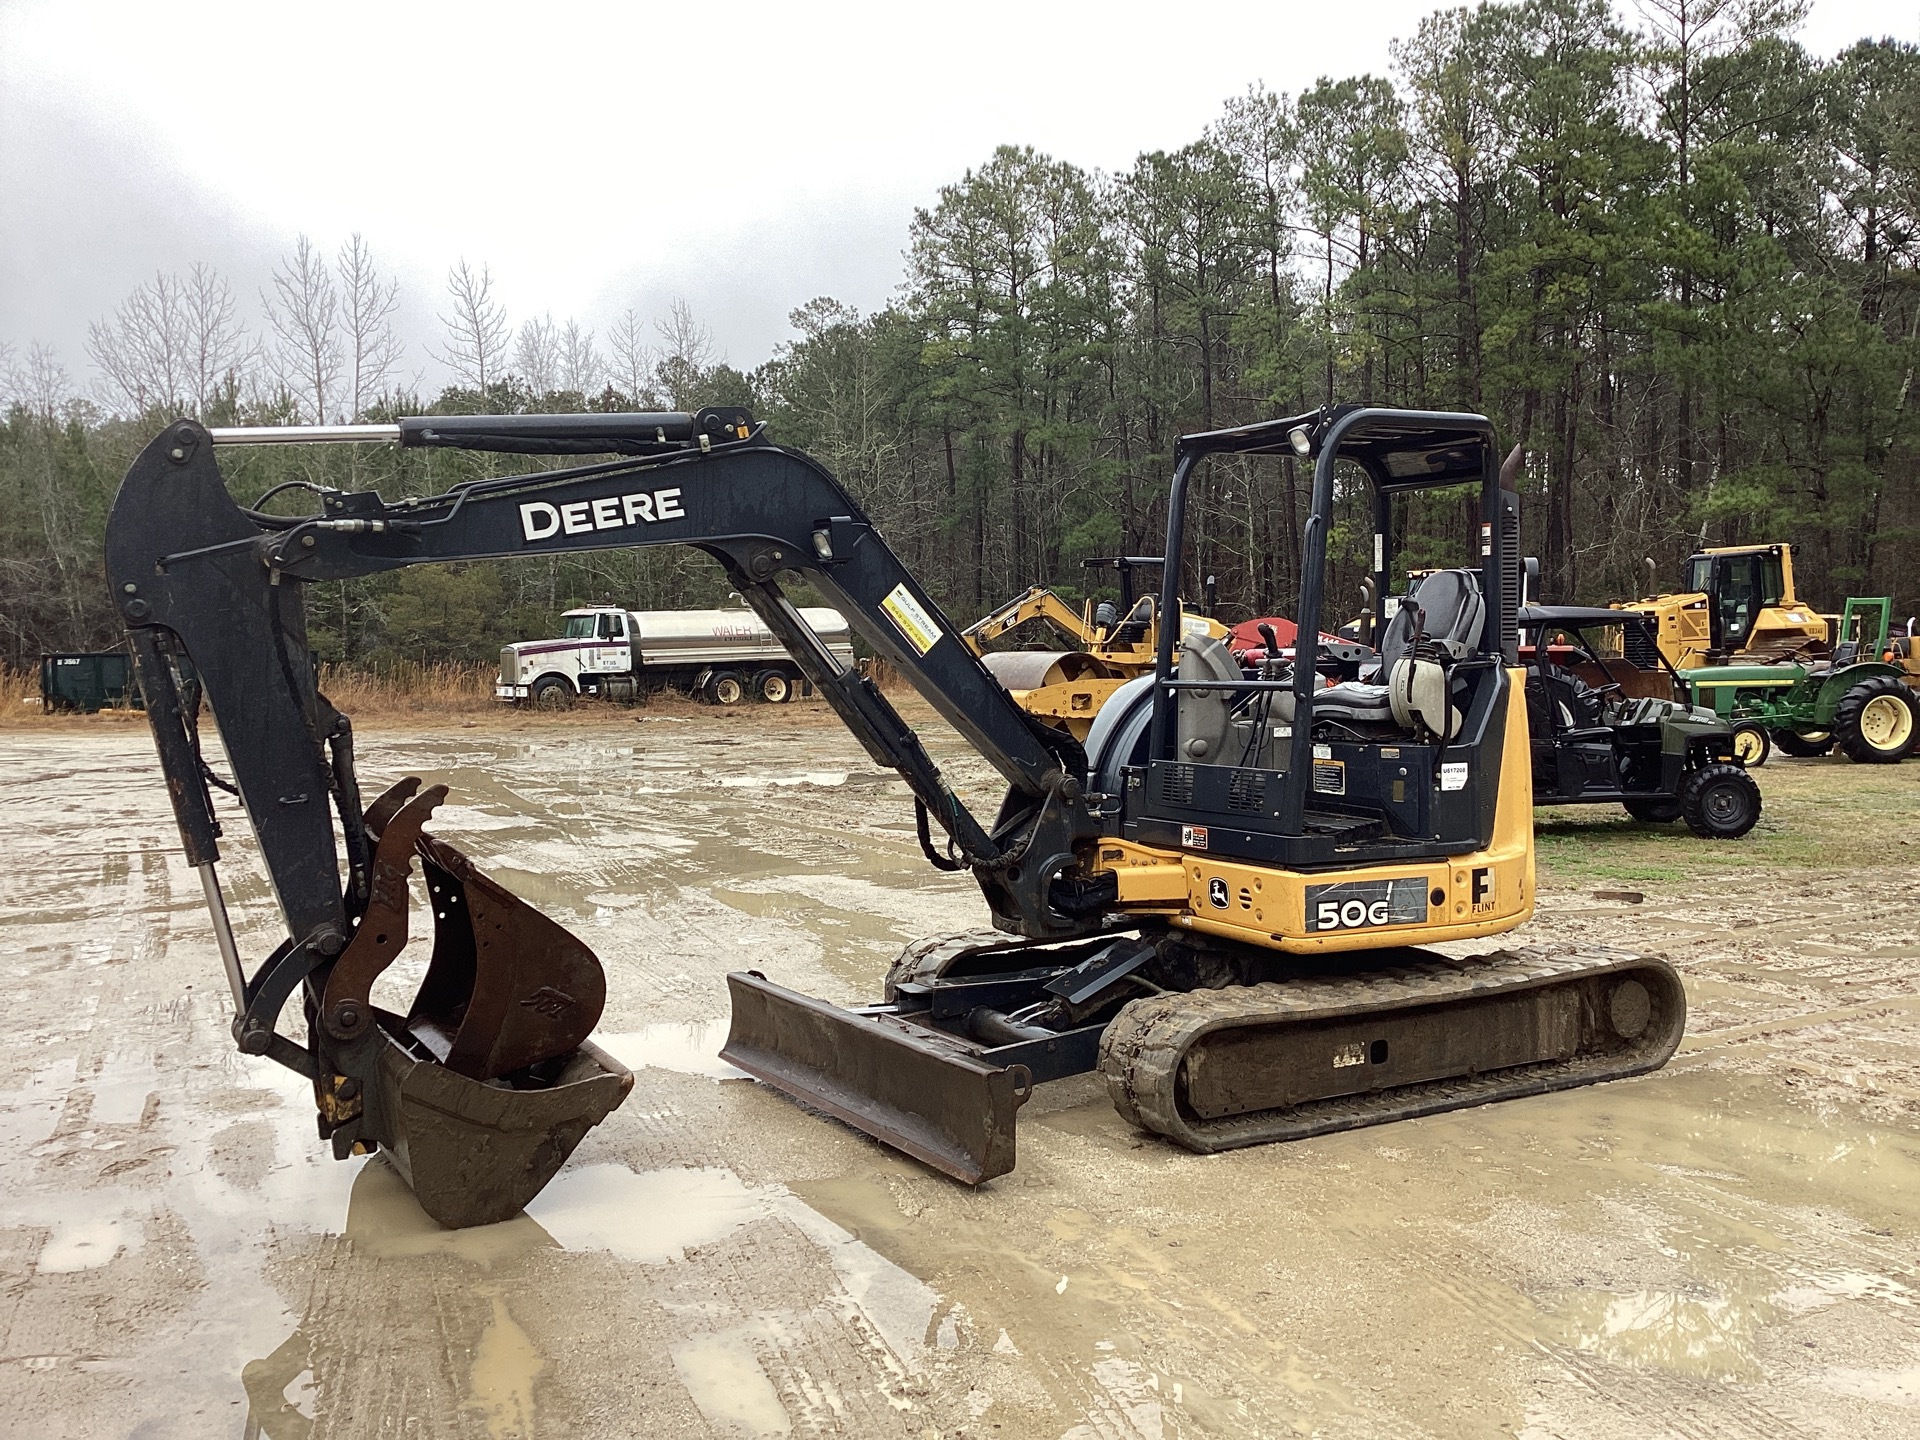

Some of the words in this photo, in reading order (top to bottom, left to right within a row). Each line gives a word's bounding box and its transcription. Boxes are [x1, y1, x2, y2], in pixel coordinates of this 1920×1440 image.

[519, 487, 685, 541] DEERE
[712, 625, 753, 637] WATER
[1317, 899, 1390, 930] 50G
[1471, 901, 1496, 914] FLINT
